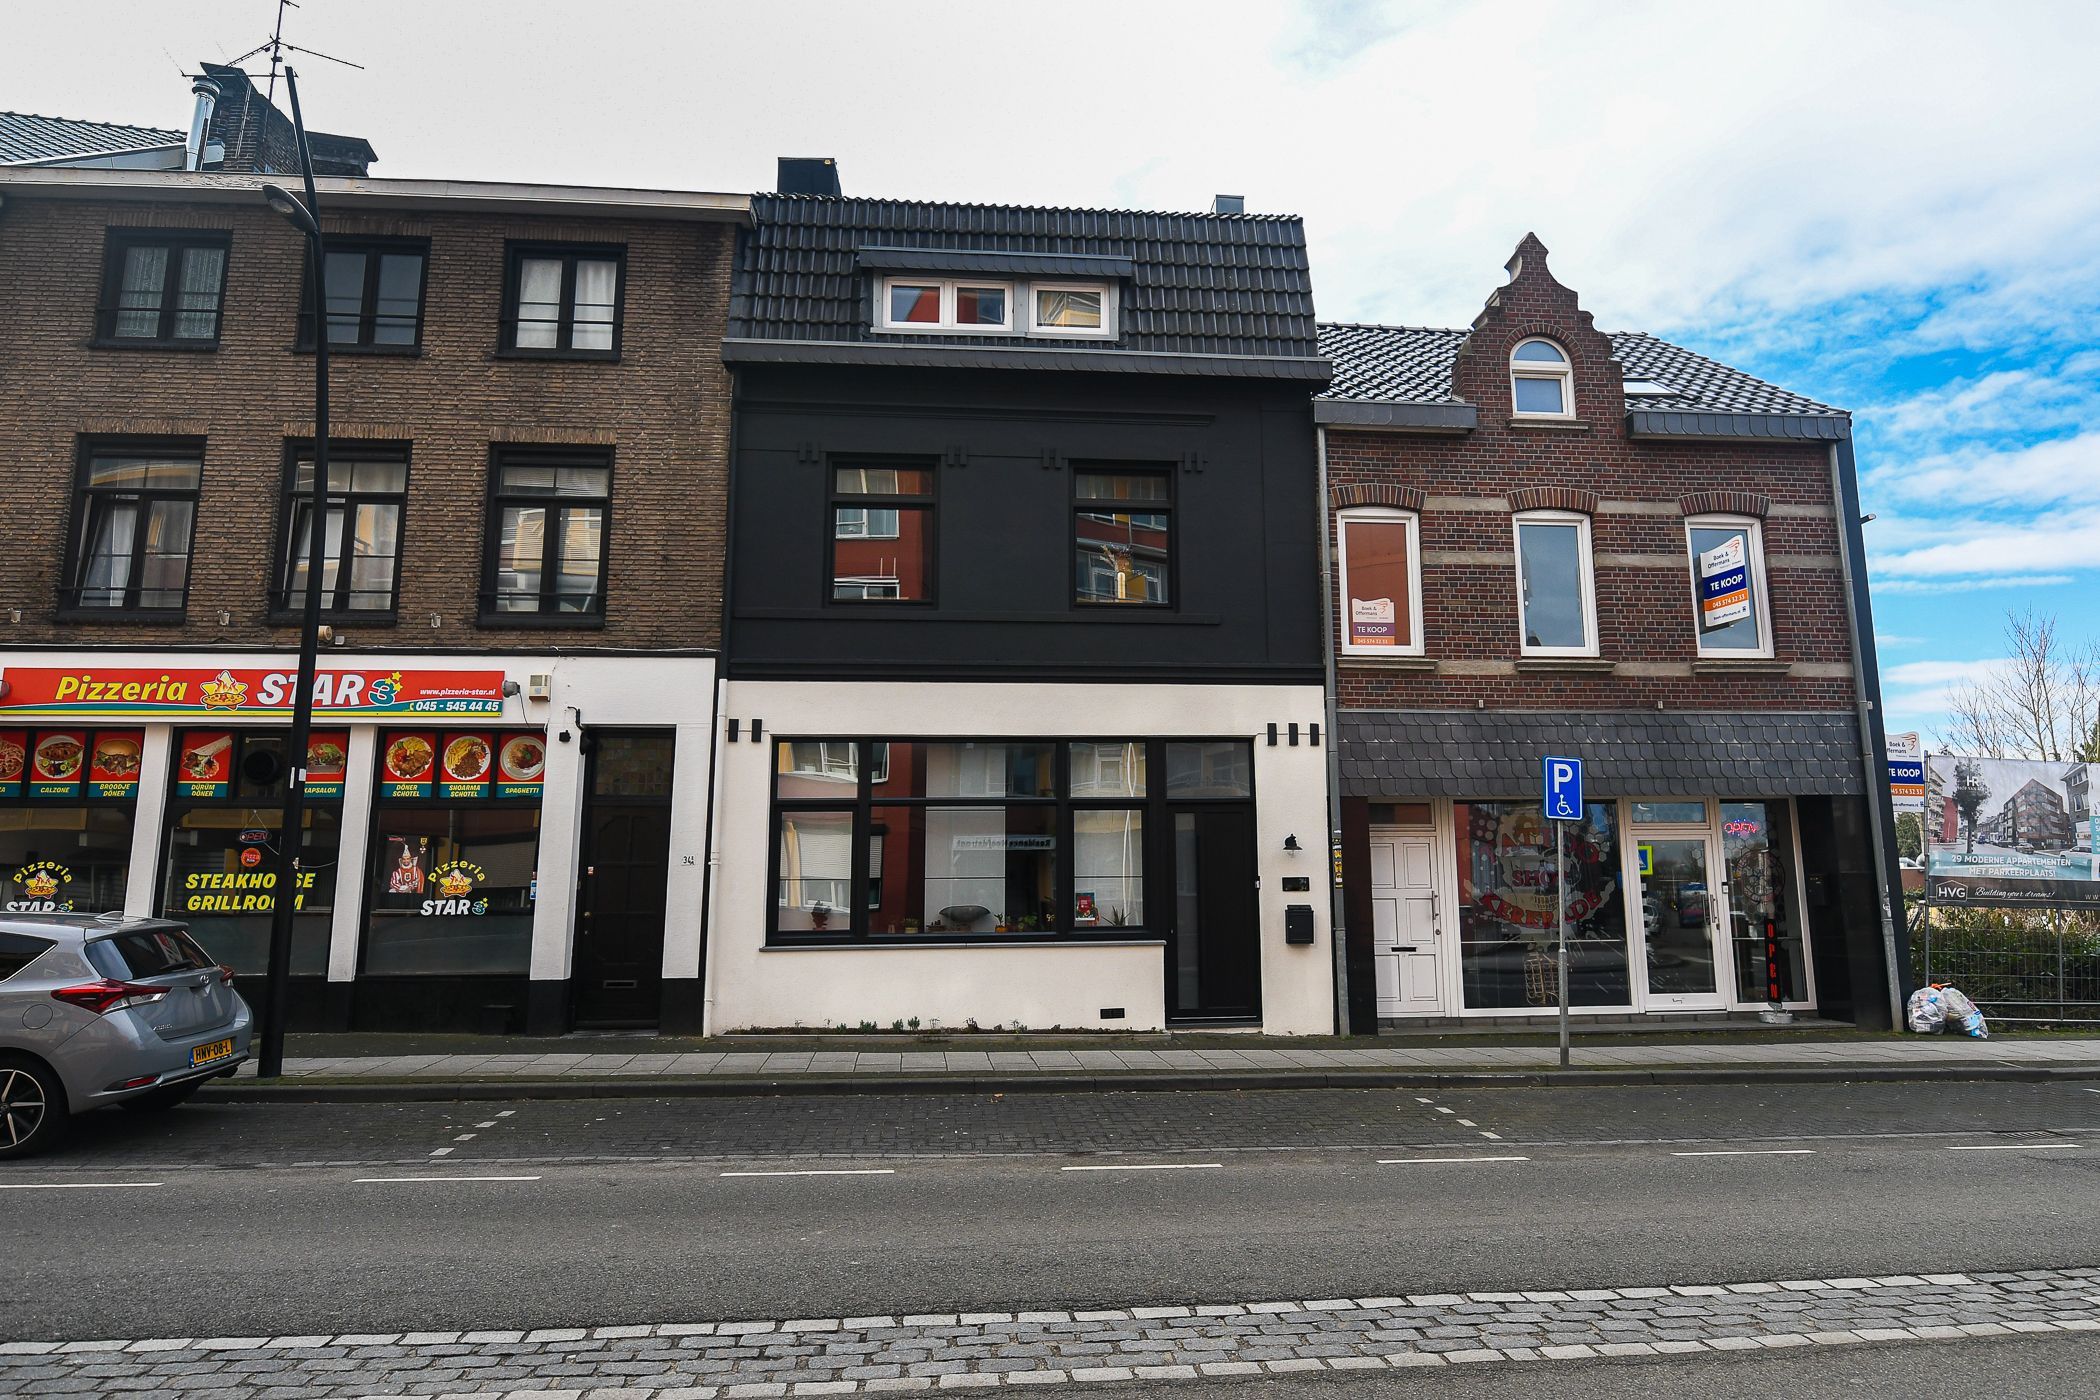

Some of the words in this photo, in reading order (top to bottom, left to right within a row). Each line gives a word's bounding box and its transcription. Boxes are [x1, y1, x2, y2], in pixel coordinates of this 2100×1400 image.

[1710, 581, 1720, 591] TE
[1720, 574, 1743, 588] KOOP
[1712, 601, 1722, 609] 045
[1722, 598, 1731, 606] 574
[1366, 626, 1388, 634] KOOP
[55, 675, 188, 701] Pizzeria
[368, 678, 397, 706] 3
[420, 688, 496, 696] www.pizzeria-star.nl
[415, 701, 437, 711] 045
[446, 701, 467, 711] 545
[468, 701, 484, 711] 44
[484, 701, 500, 711] 45
[1553, 763, 1573, 793] P
[1888, 768, 1896, 776] TE
[1897, 768, 1920, 777] KOOP
[1966, 775, 1979, 787] HR
[103, 789, 126, 797] DÖNER
[1951, 855, 1962, 863] 29
[1964, 855, 2005, 864] MODERNE
[1968, 867, 1986, 875] MET
[1988, 867, 2056, 878] PARKEERPLAATS!
[185, 873, 316, 889] STEAKHOSE
[1938, 886, 1966, 898] HVG
[1975, 887, 2006, 899] Building
[2007, 890, 2024, 898] your
[187, 894, 304, 911] GRILLROM
[420, 899, 471, 916] STAR
[1767, 923, 1778, 999] OPEN
[195, 1042, 231, 1061] HNV-08-L
